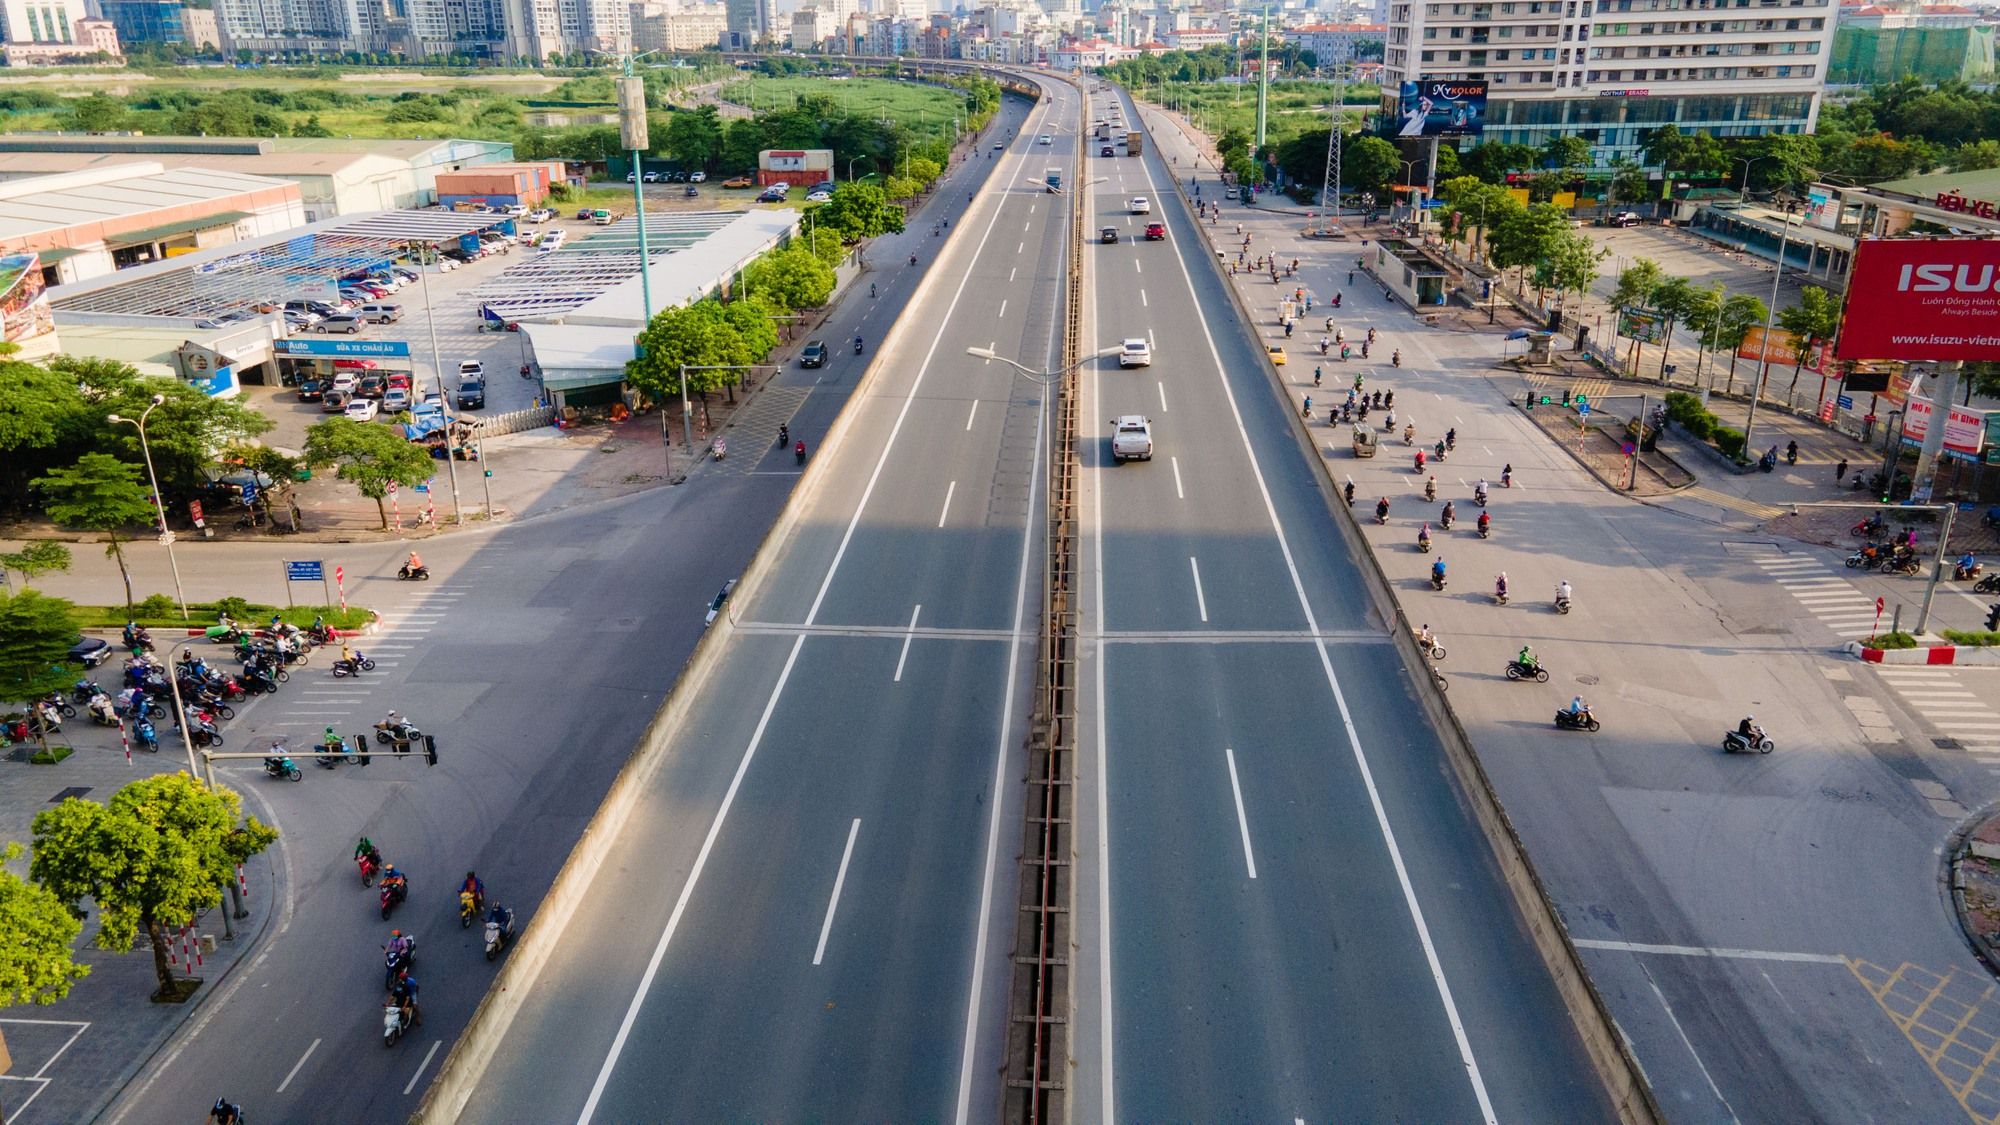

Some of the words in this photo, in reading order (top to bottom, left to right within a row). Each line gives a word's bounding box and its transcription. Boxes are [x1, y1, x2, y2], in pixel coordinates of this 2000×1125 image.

[1972, 199, 1994, 218] XE
[1897, 264, 2000, 293] ISU
[1941, 307, 1970, 317] Always
